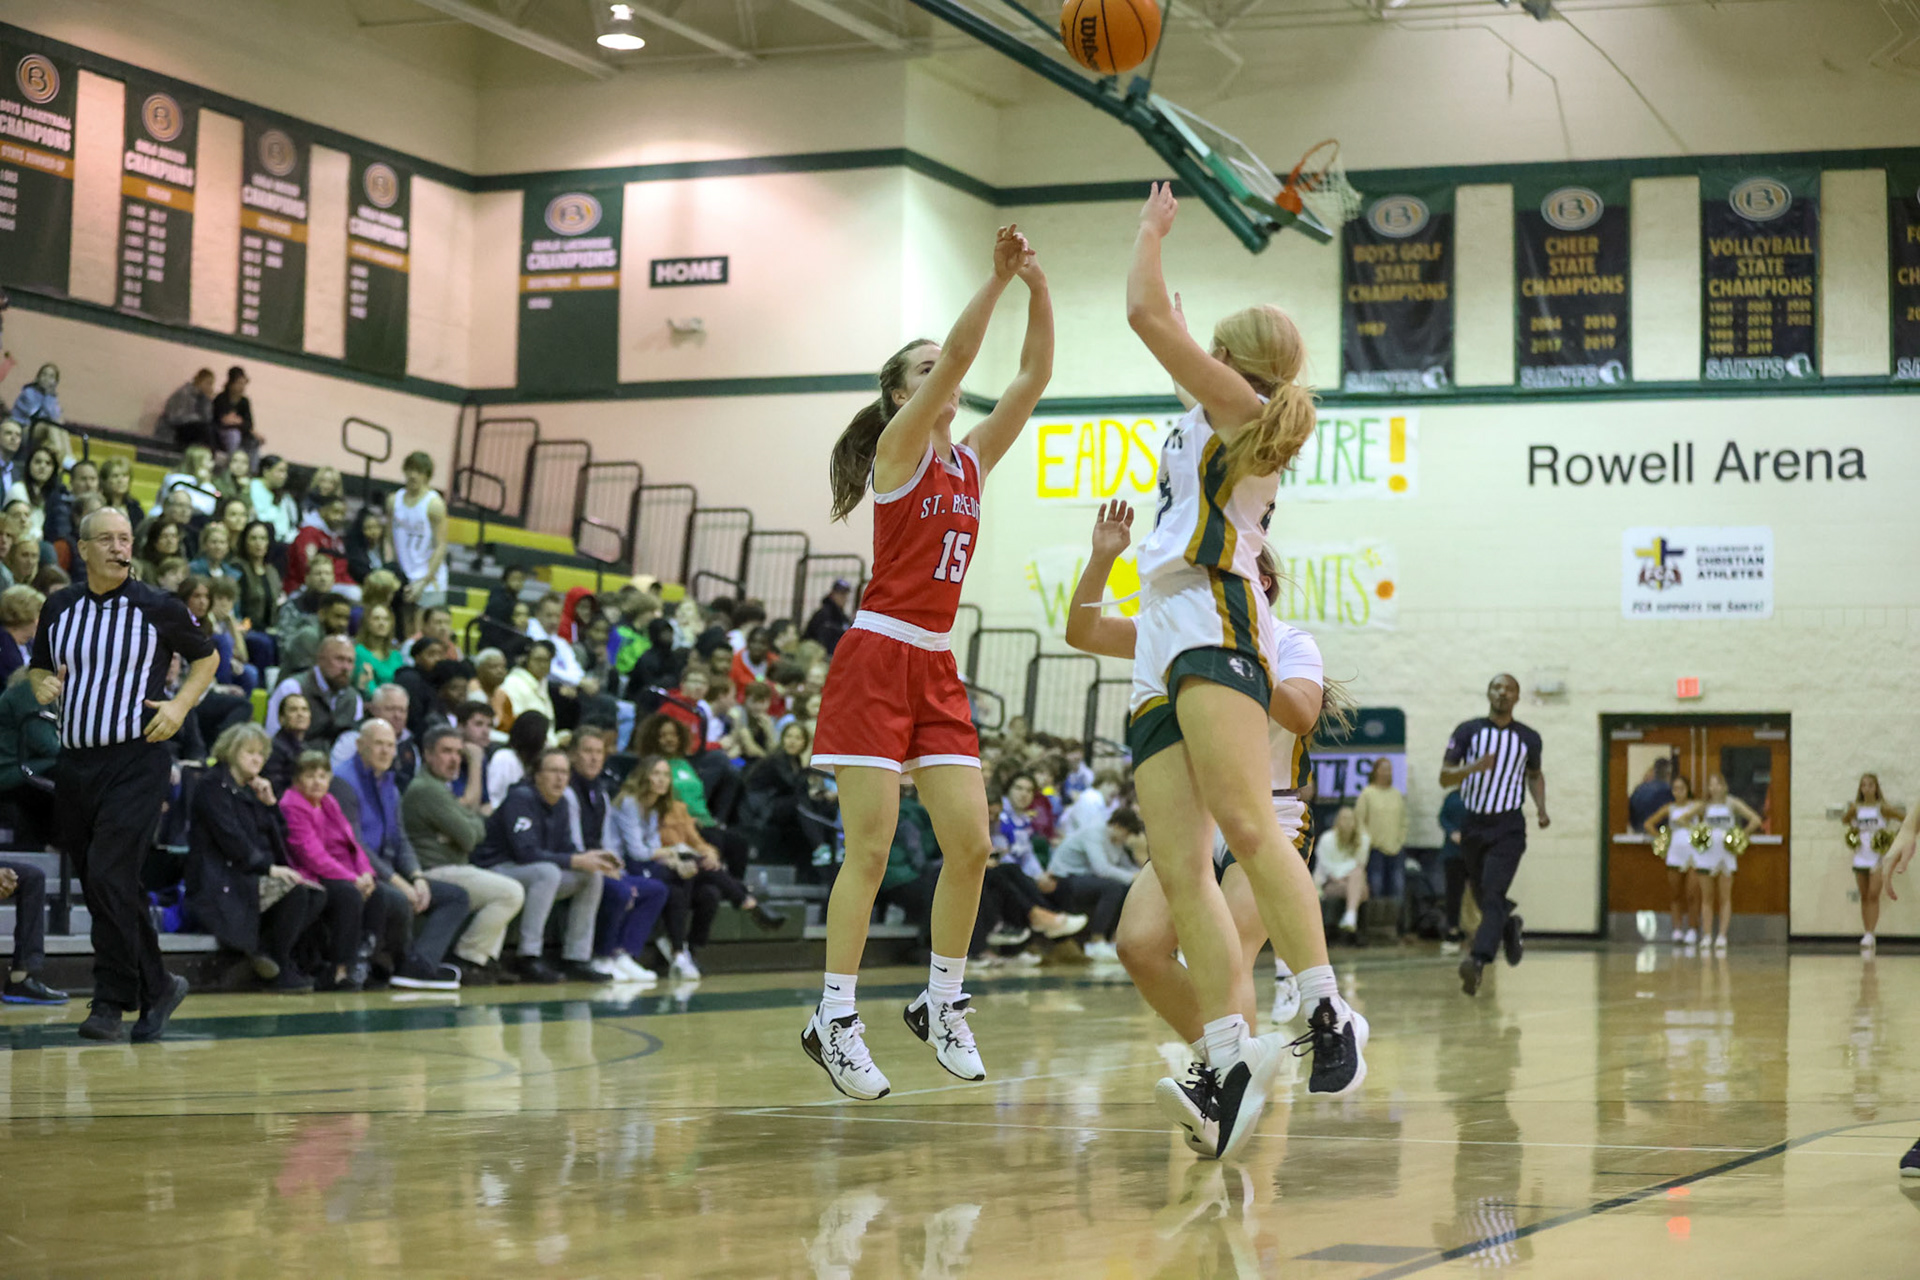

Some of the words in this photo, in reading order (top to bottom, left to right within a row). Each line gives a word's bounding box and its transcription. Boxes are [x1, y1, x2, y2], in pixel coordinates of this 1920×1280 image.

[0, 114, 71, 151] CHAMPIONS
[1545, 236, 1599, 254] CHEER
[1709, 237, 1813, 257] VOLLEYBALL
[526, 251, 616, 271] CHAMPIONS
[656, 260, 723, 282] HOME
[1549, 256, 1597, 275] STATE
[1736, 257, 1785, 276] STATE
[1375, 264, 1420, 282] STATE
[1348, 283, 1448, 302] CHAMPIONS
[1522, 275, 1625, 297] CHAMPIONS
[1709, 277, 1813, 298] CHAMPIONS
[1706, 357, 1785, 380] SAINTS
[1528, 442, 1694, 486] Rowell
[1714, 441, 1867, 483] Arena
[920, 494, 946, 519] ST.
[933, 529, 972, 583] 15
[1696, 557, 1765, 565] CHRISTIAN
[1697, 570, 1764, 579] ATHLETES
